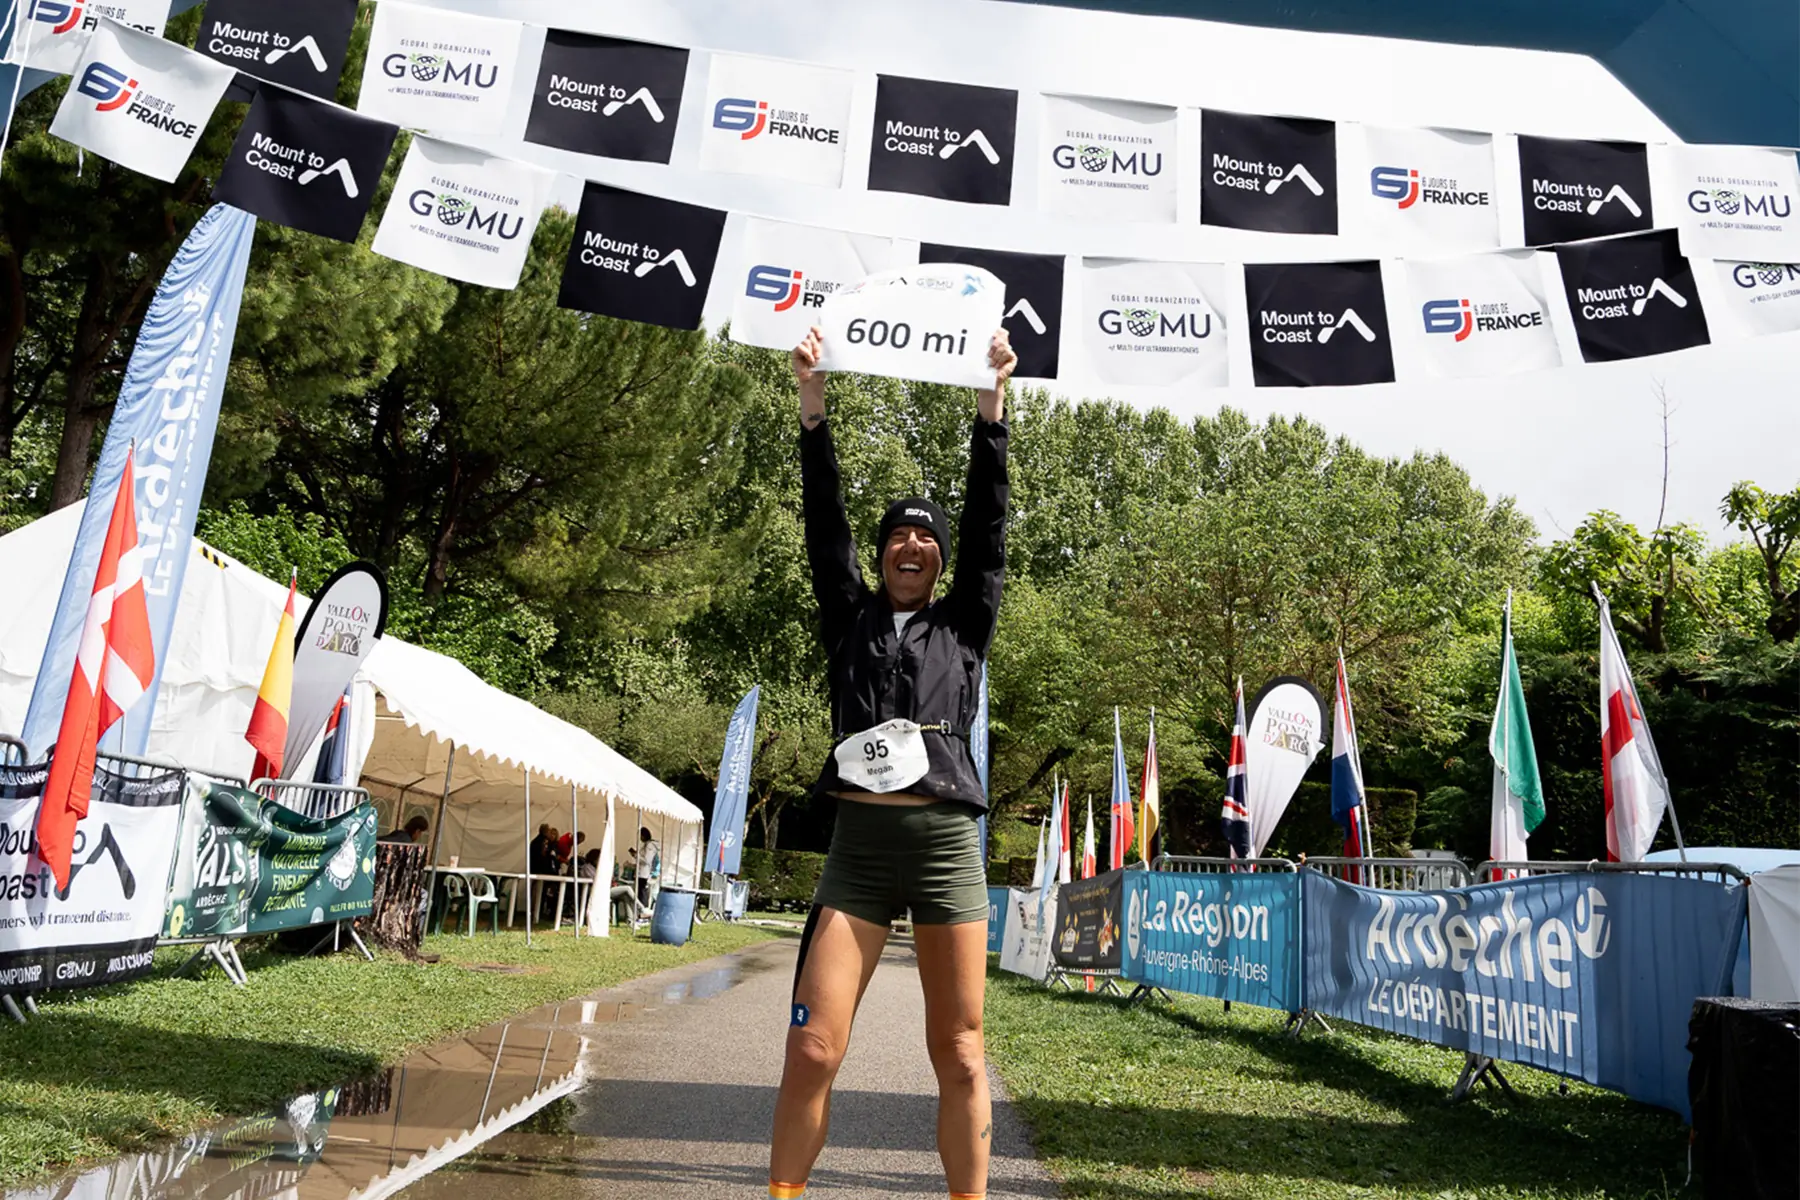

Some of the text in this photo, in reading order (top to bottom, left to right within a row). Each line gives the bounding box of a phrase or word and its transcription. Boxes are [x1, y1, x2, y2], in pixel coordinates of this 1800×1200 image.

[212, 22, 291, 48] Mount to
[208, 38, 261, 61] Coast
[400, 39, 491, 56] GLOBAL ORGANIZATION
[382, 53, 498, 89] GOMU
[550, 74, 626, 100] Mount to
[141, 94, 165, 111] JOURS
[163, 102, 176, 115] DE
[547, 91, 598, 113] Coast
[126, 102, 197, 139] FRANCE
[776, 109, 798, 123] JOURS
[800, 113, 809, 124] DE
[769, 121, 839, 144] FRANCE
[886, 120, 960, 143] Mount to
[1066, 130, 1153, 144] GLOBAL ORGANIZATION
[251, 132, 325, 168] Mount to
[884, 137, 934, 156] Coast
[245, 150, 295, 180] Coast
[1053, 144, 1162, 176] GOMU
[1213, 153, 1283, 178] Mount to
[431, 176, 519, 206] GLOBAL ORGANIZATION
[1213, 170, 1260, 192] Coast
[1428, 177, 1447, 189] JOURS
[1449, 179, 1457, 190] DE
[1533, 179, 1603, 198] Mount to
[1423, 189, 1489, 206] FRANCE
[1534, 195, 1582, 213] Coast
[1688, 189, 1791, 218] GOMU
[409, 189, 524, 240] GOMU
[583, 230, 660, 261] Mount to
[580, 249, 630, 273] Coast
[811, 280, 834, 293] JOURS
[1577, 283, 1645, 304] Mount to
[1111, 294, 1200, 304] GLOBAL ORGANIZATION
[1480, 304, 1499, 315] JOURS
[1500, 302, 1509, 314] DE
[1261, 310, 1334, 327] Mount to
[1476, 311, 1543, 332] FRANCE
[1582, 303, 1628, 321] Coast
[1098, 309, 1211, 339] GOMU
[1264, 327, 1312, 343] Coast
[847, 318, 968, 356] 600 mi
[328, 604, 371, 623] VALLON
[320, 616, 367, 639] PONT
[1268, 706, 1314, 728] VALLON
[1266, 718, 1312, 740] PONT
[863, 739, 889, 762] 95
[867, 765, 894, 776] Megan
[1142, 889, 1269, 948] La Région
[1366, 889, 1573, 989] Ardèche
[1142, 943, 1269, 984] Auvergne-Rhône-Alpes
[1367, 973, 1579, 1058] LE DÉPARTEMENT
